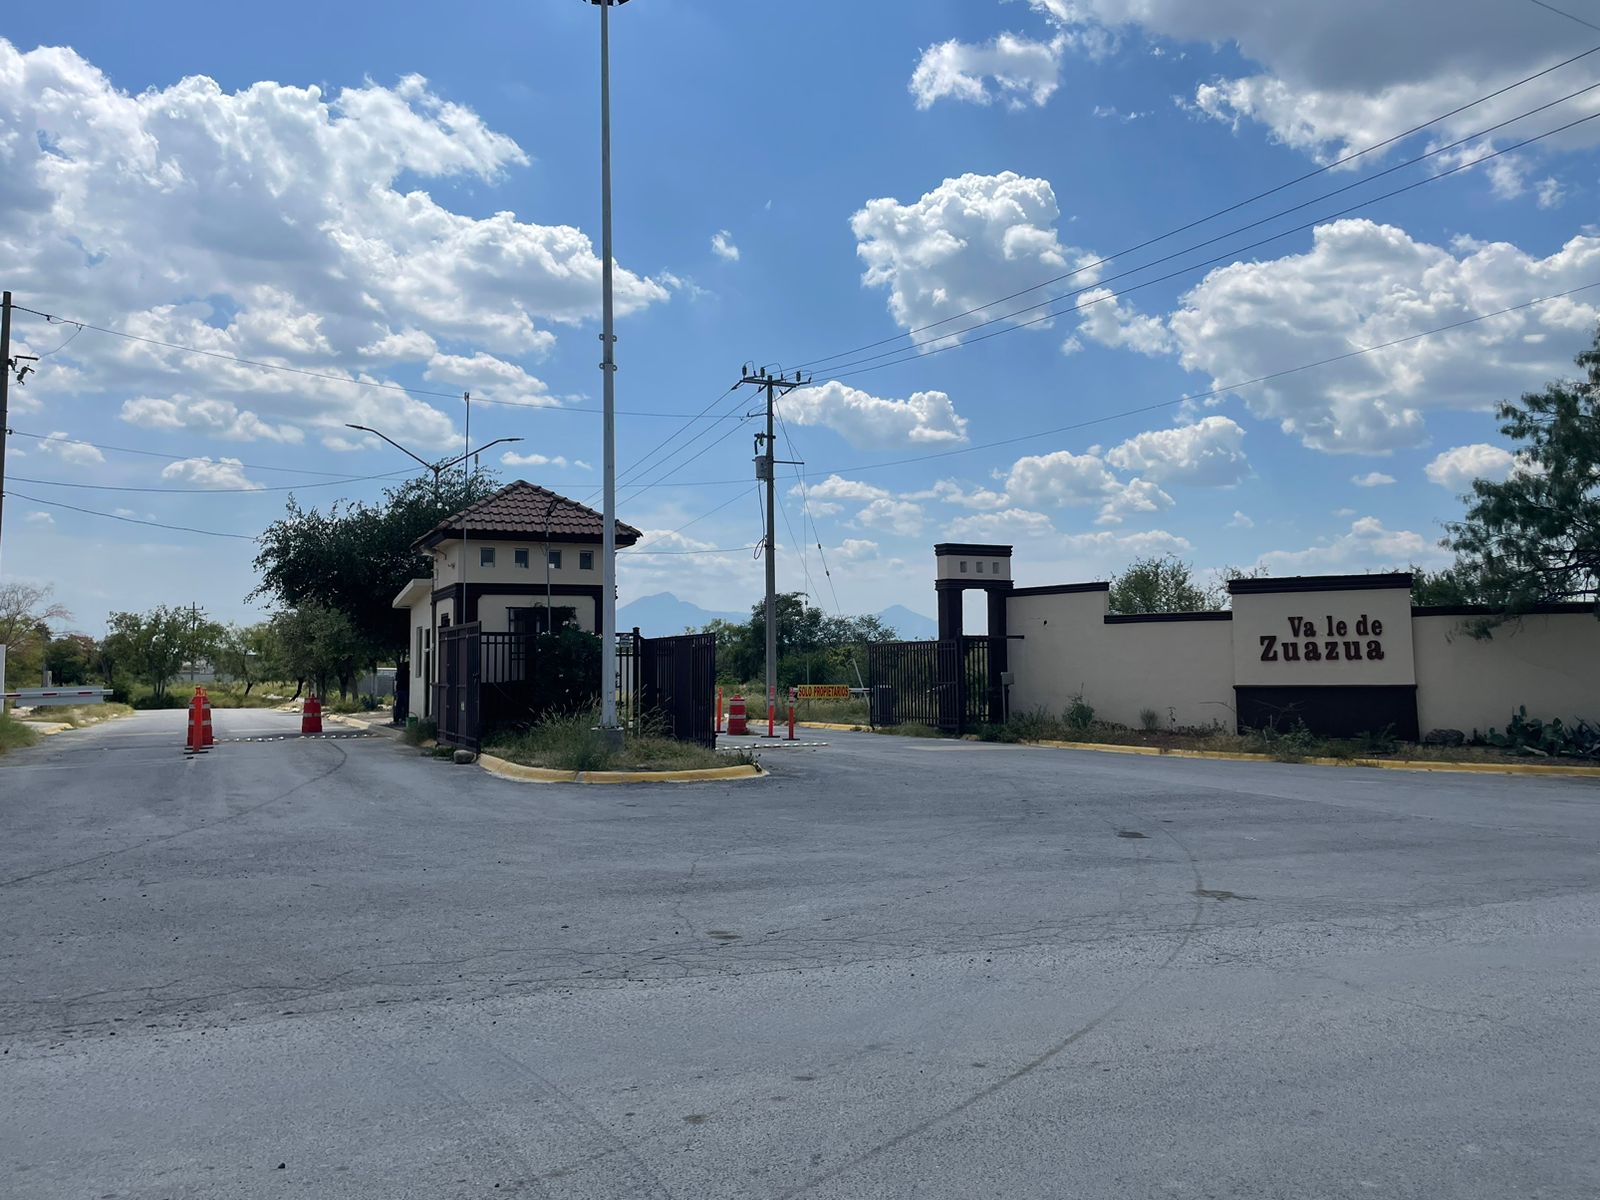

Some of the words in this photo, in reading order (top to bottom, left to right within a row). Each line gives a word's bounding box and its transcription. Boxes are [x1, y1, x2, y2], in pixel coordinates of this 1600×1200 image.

[1259, 635, 1385, 662] Zuazua
[798, 686, 812, 697] SOLO
[814, 686, 849, 697] PROPIETARIOS
